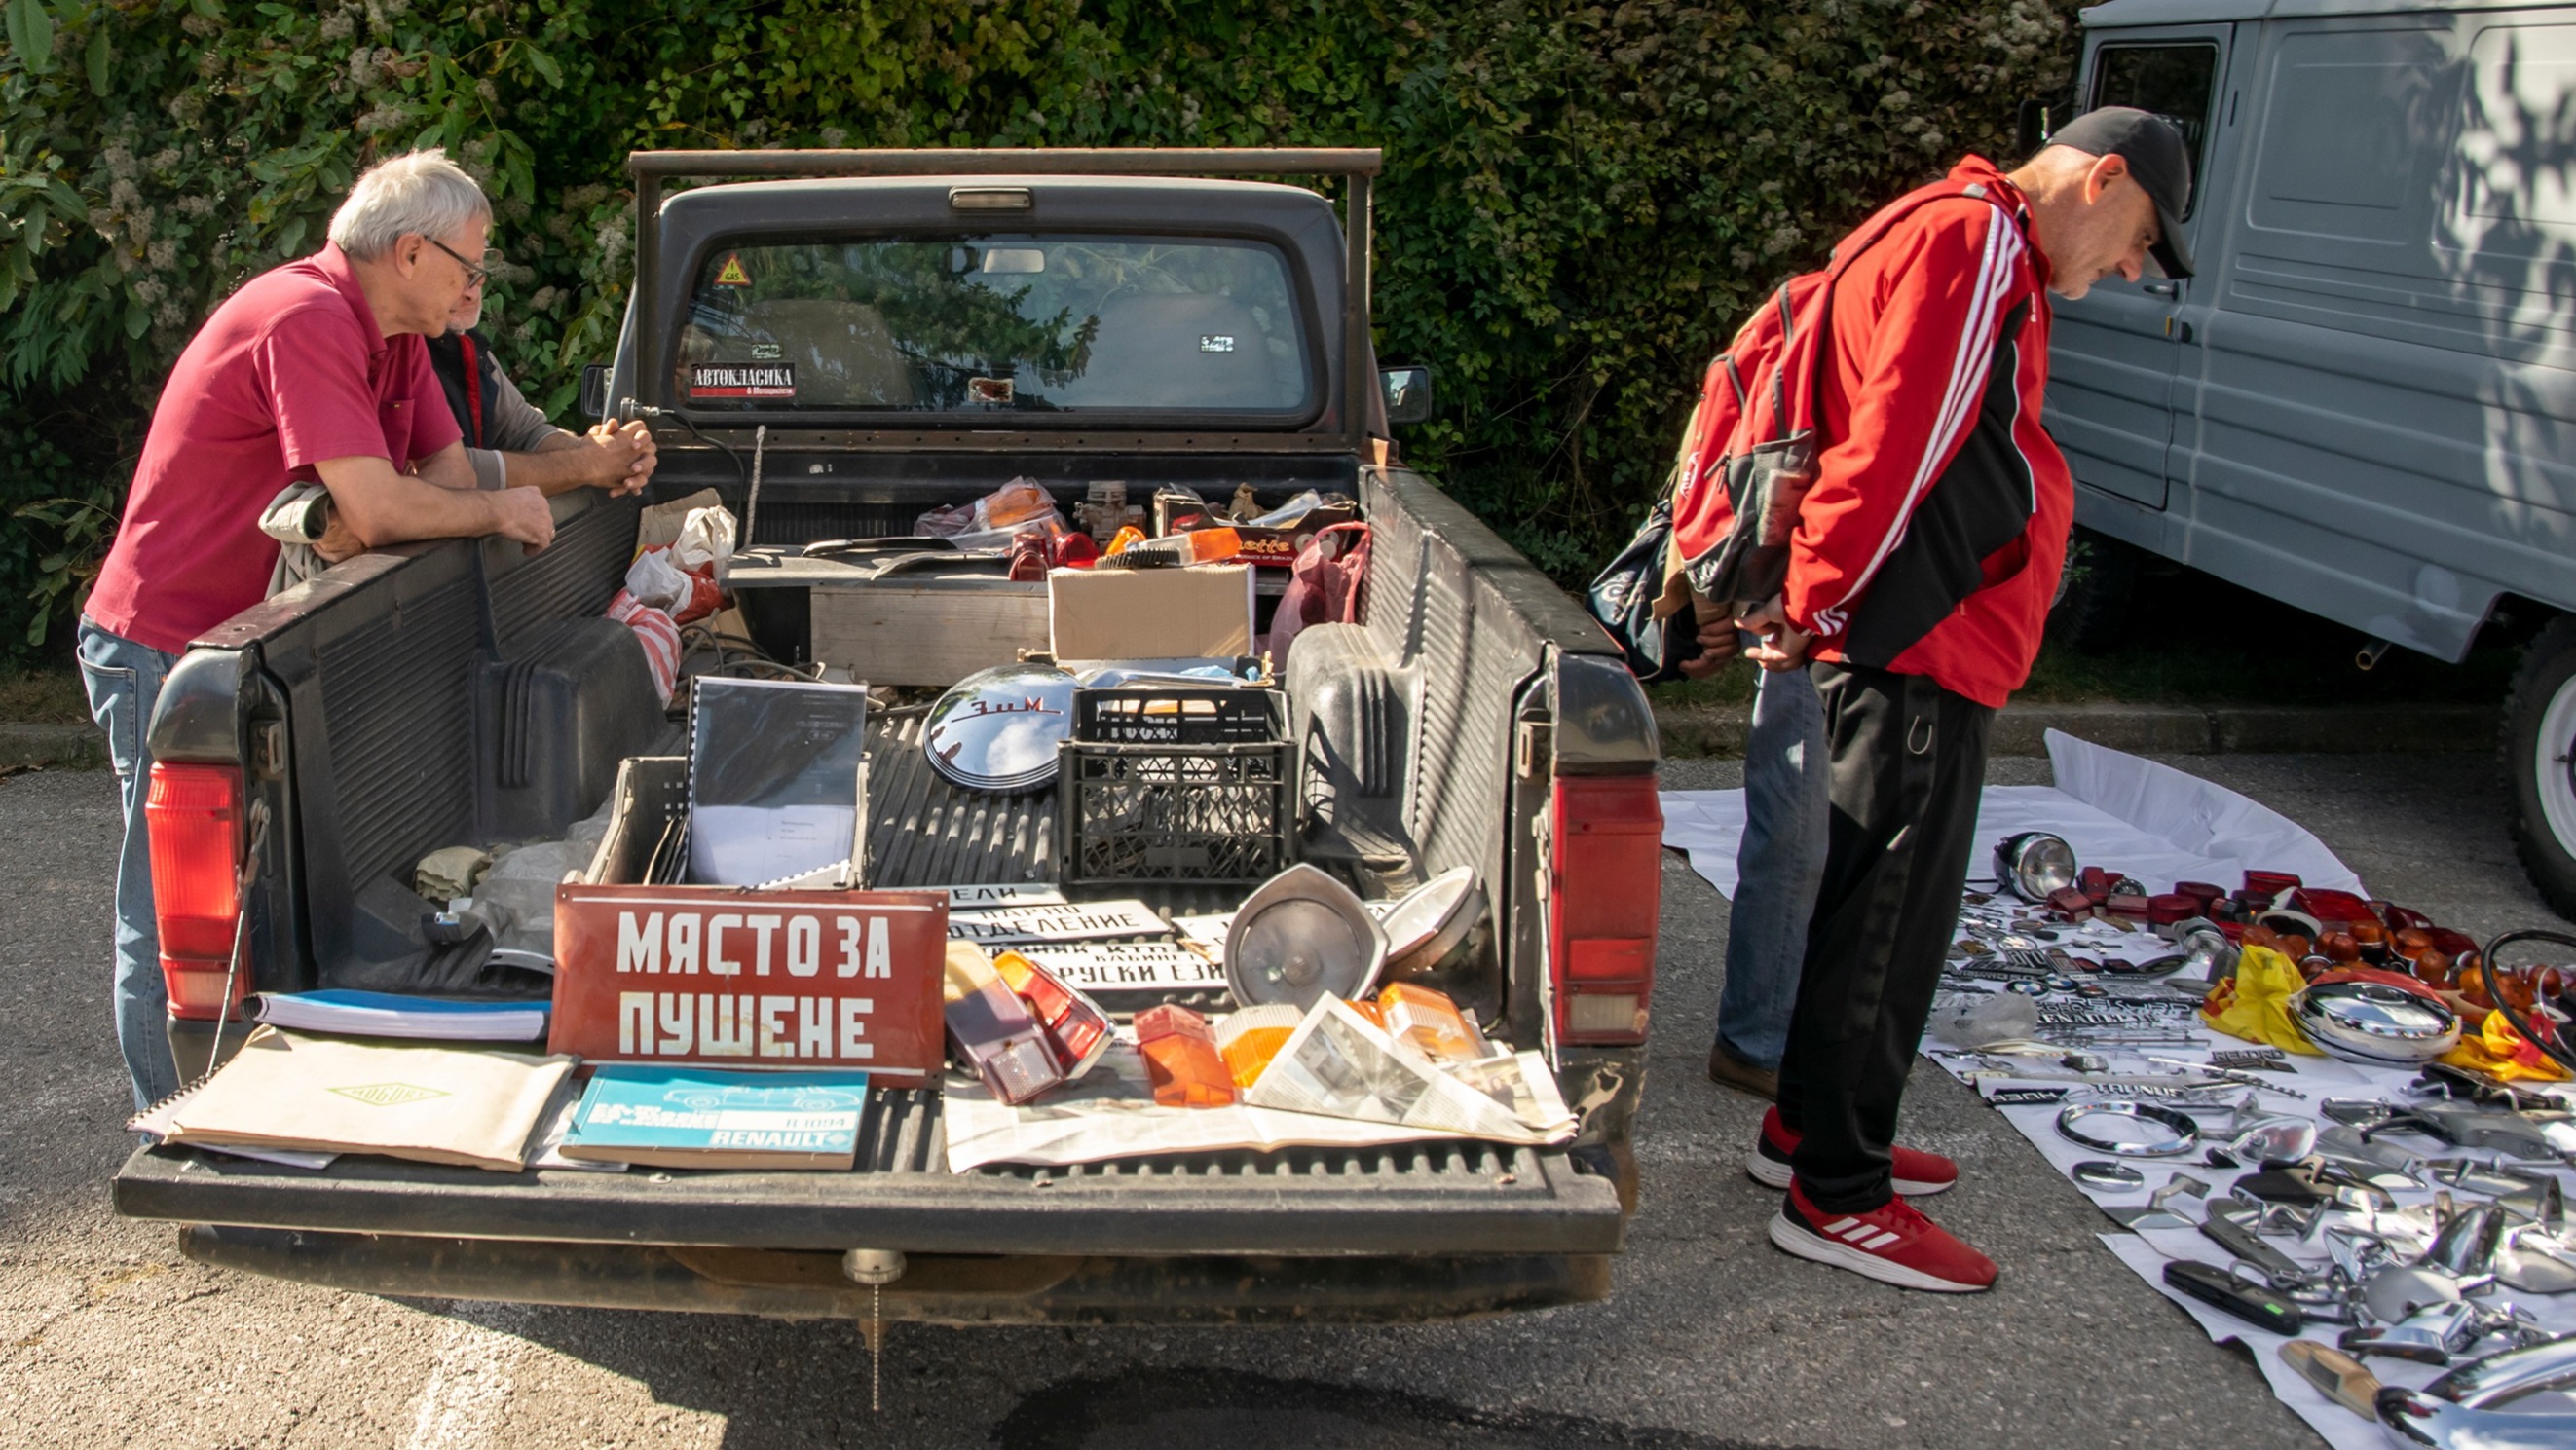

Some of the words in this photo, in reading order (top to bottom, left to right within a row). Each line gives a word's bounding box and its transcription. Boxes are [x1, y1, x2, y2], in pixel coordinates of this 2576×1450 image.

[694, 369, 793, 386] АВТОКЛАСИКА
[953, 888, 1016, 901] ЕЛИ
[949, 913, 1141, 940] ОТДЕЛЕНИЕ
[616, 911, 821, 977] МЯСТО
[837, 916, 892, 979] ЗА
[1059, 965, 1156, 983] РУСКИ
[1170, 963, 1227, 981] ЕЗИ
[618, 991, 875, 1060] ПУШЕНЕ
[2211, 1050, 2286, 1061] REKORD
[2093, 1083, 2184, 1097] TAUNUS
[804, 1117, 846, 1128] 1094
[710, 1131, 830, 1148] RENAULT
